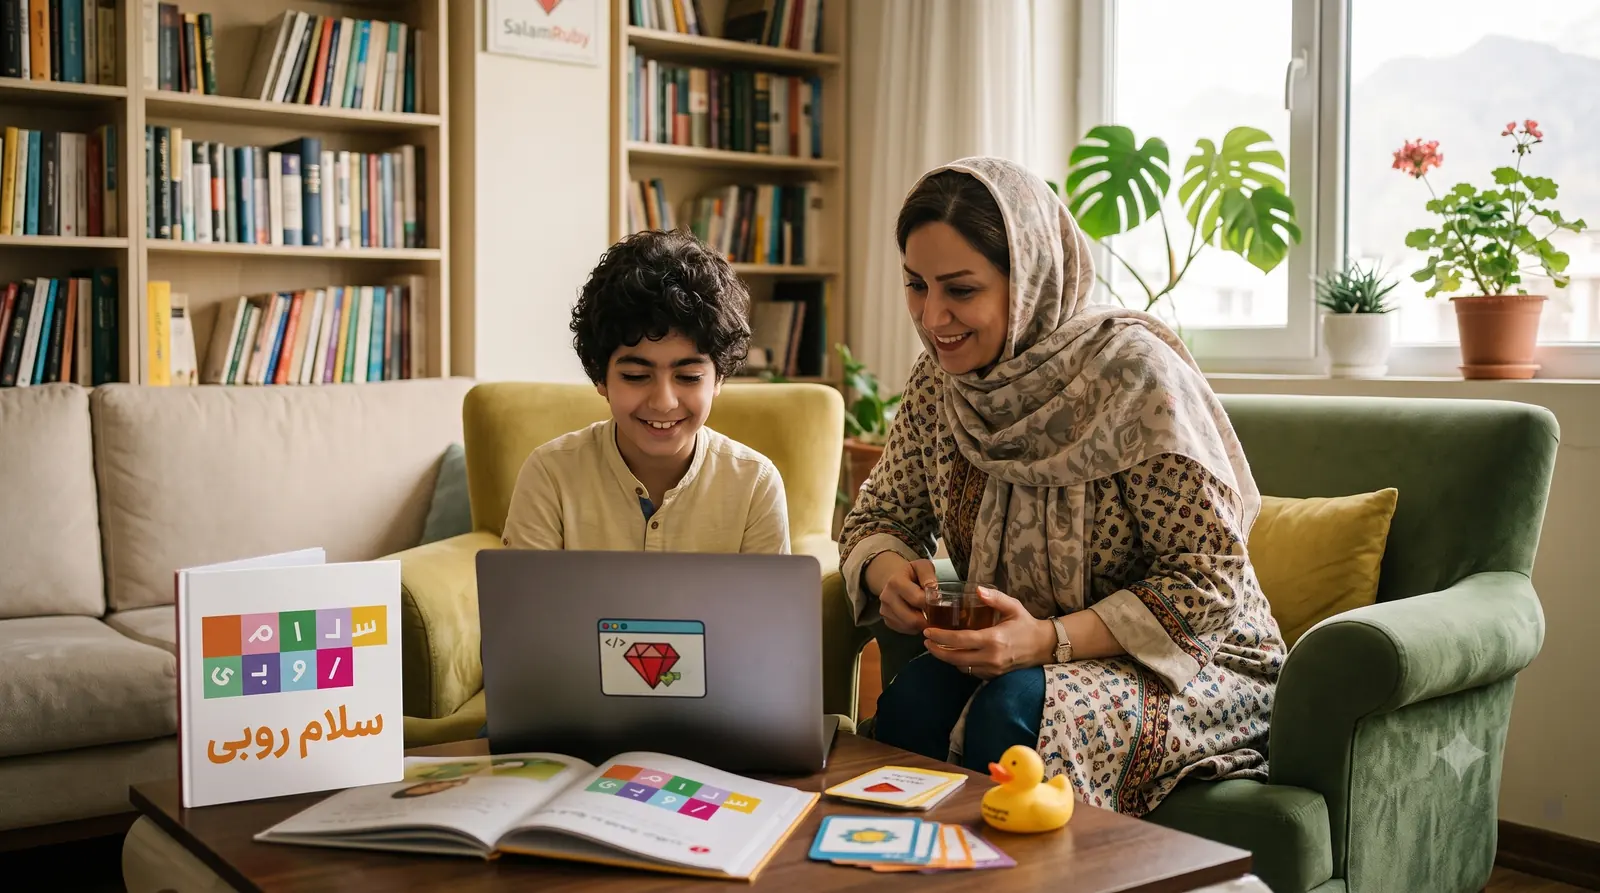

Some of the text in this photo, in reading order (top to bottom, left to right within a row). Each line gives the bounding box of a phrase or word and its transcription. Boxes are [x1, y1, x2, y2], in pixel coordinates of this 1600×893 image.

[503, 18, 589, 48] SalamRuby
[207, 704, 383, 764] سلام روبی
